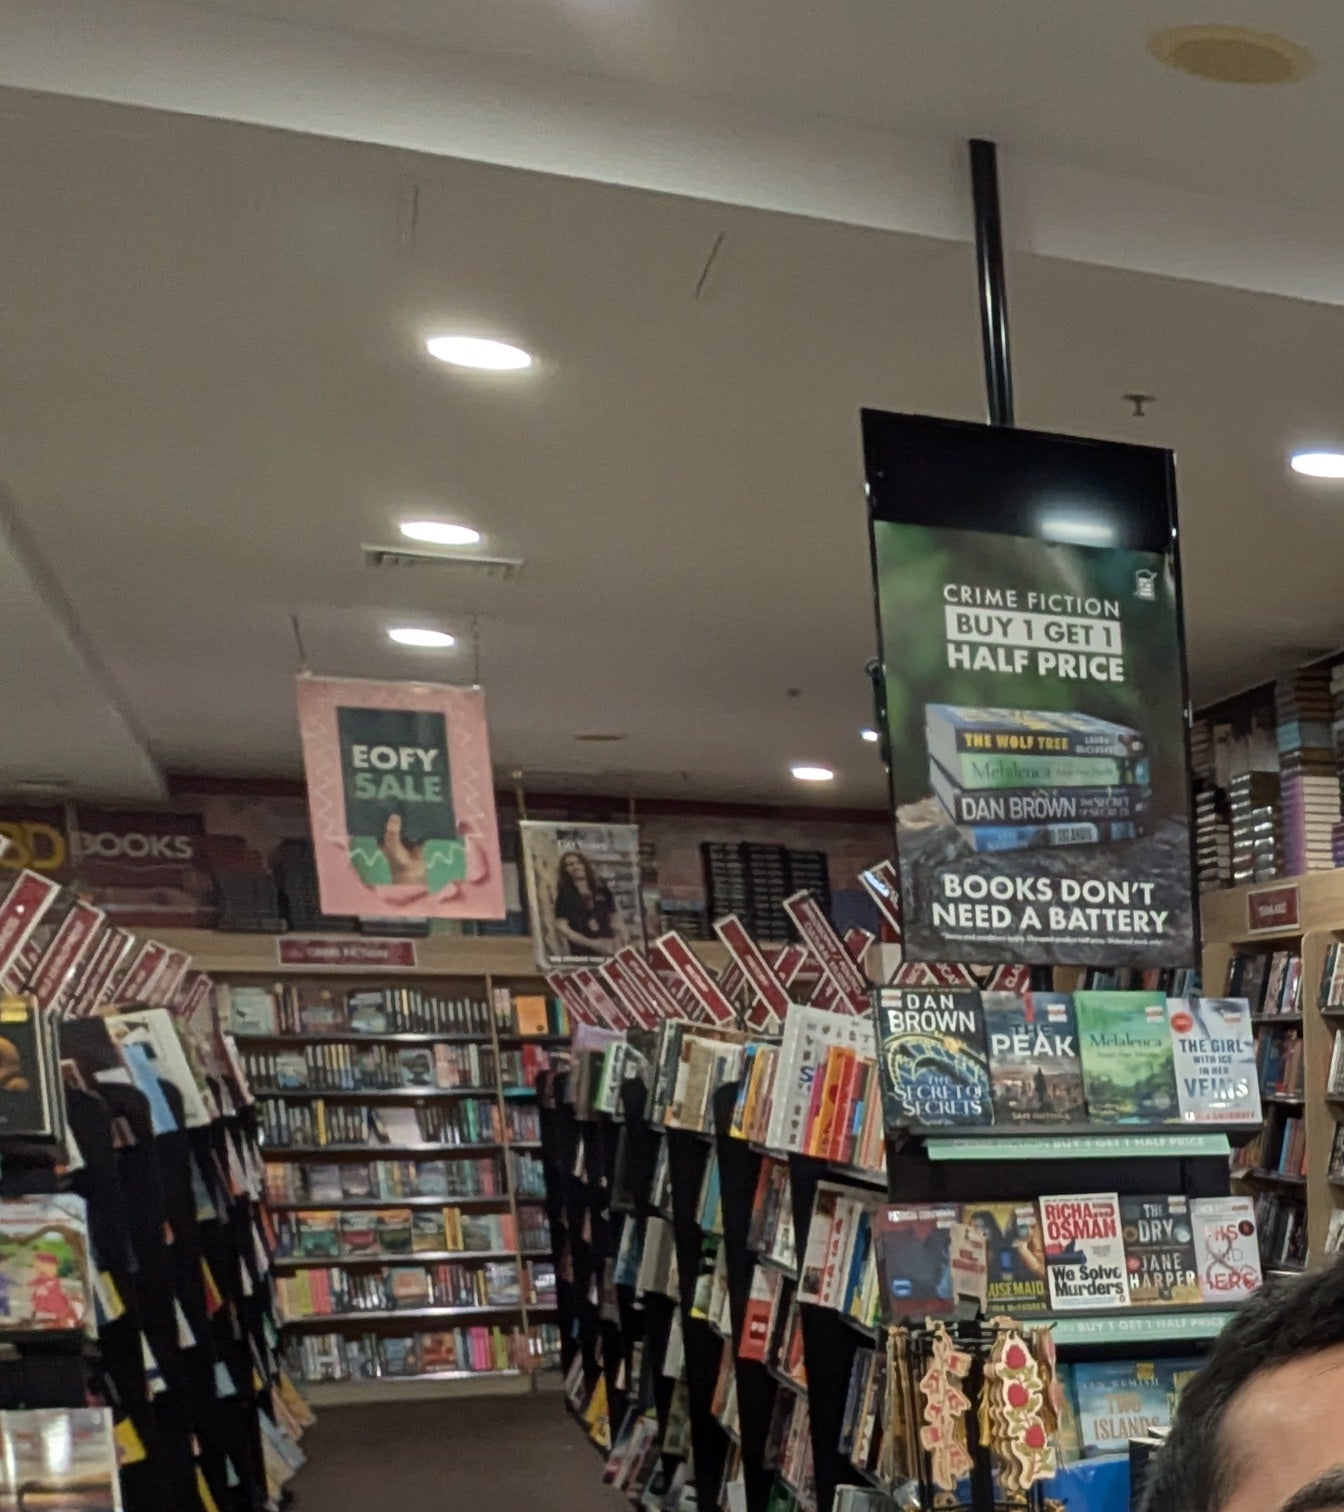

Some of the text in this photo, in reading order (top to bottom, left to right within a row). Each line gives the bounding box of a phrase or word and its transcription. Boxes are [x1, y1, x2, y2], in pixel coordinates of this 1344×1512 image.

[944, 584, 1120, 618] CRIME FICTION
[956, 613, 1113, 648] BUY 1 GET 1
[947, 644, 1124, 682] HALF PRICE
[963, 733, 1068, 751] THE WOLF TREE
[352, 744, 439, 771] EOFY
[355, 774, 442, 802] SALE
[961, 796, 1004, 821] DAN
[1009, 796, 1077, 820] BROWN
[943, 873, 1154, 905] BOOKS DON'T
[932, 902, 1168, 934] NEED A BATTERY
[907, 994, 954, 1010] DAN
[888, 1010, 976, 1033] BROWN
[1011, 1022, 1051, 1036] THE
[991, 1032, 1075, 1057] PEAK
[1090, 1033, 1162, 1048] Melaleuca
[1179, 1039, 1244, 1053] THE GIRL
[1053, 1138, 1081, 1148] BUY
[1047, 1219, 1117, 1240] OSMAN
[1138, 1219, 1175, 1243] DRY
[1053, 1265, 1122, 1281] We Solve
[1141, 1253, 1181, 1272] JANE
[1055, 1281, 1125, 1297] Murders
[1129, 1271, 1196, 1289] HARPER
[1077, 1320, 1104, 1333] BUY
[1121, 1320, 1144, 1330] GET
[1157, 1317, 1187, 1329] HALF
[1190, 1317, 1224, 1327] PRICE
